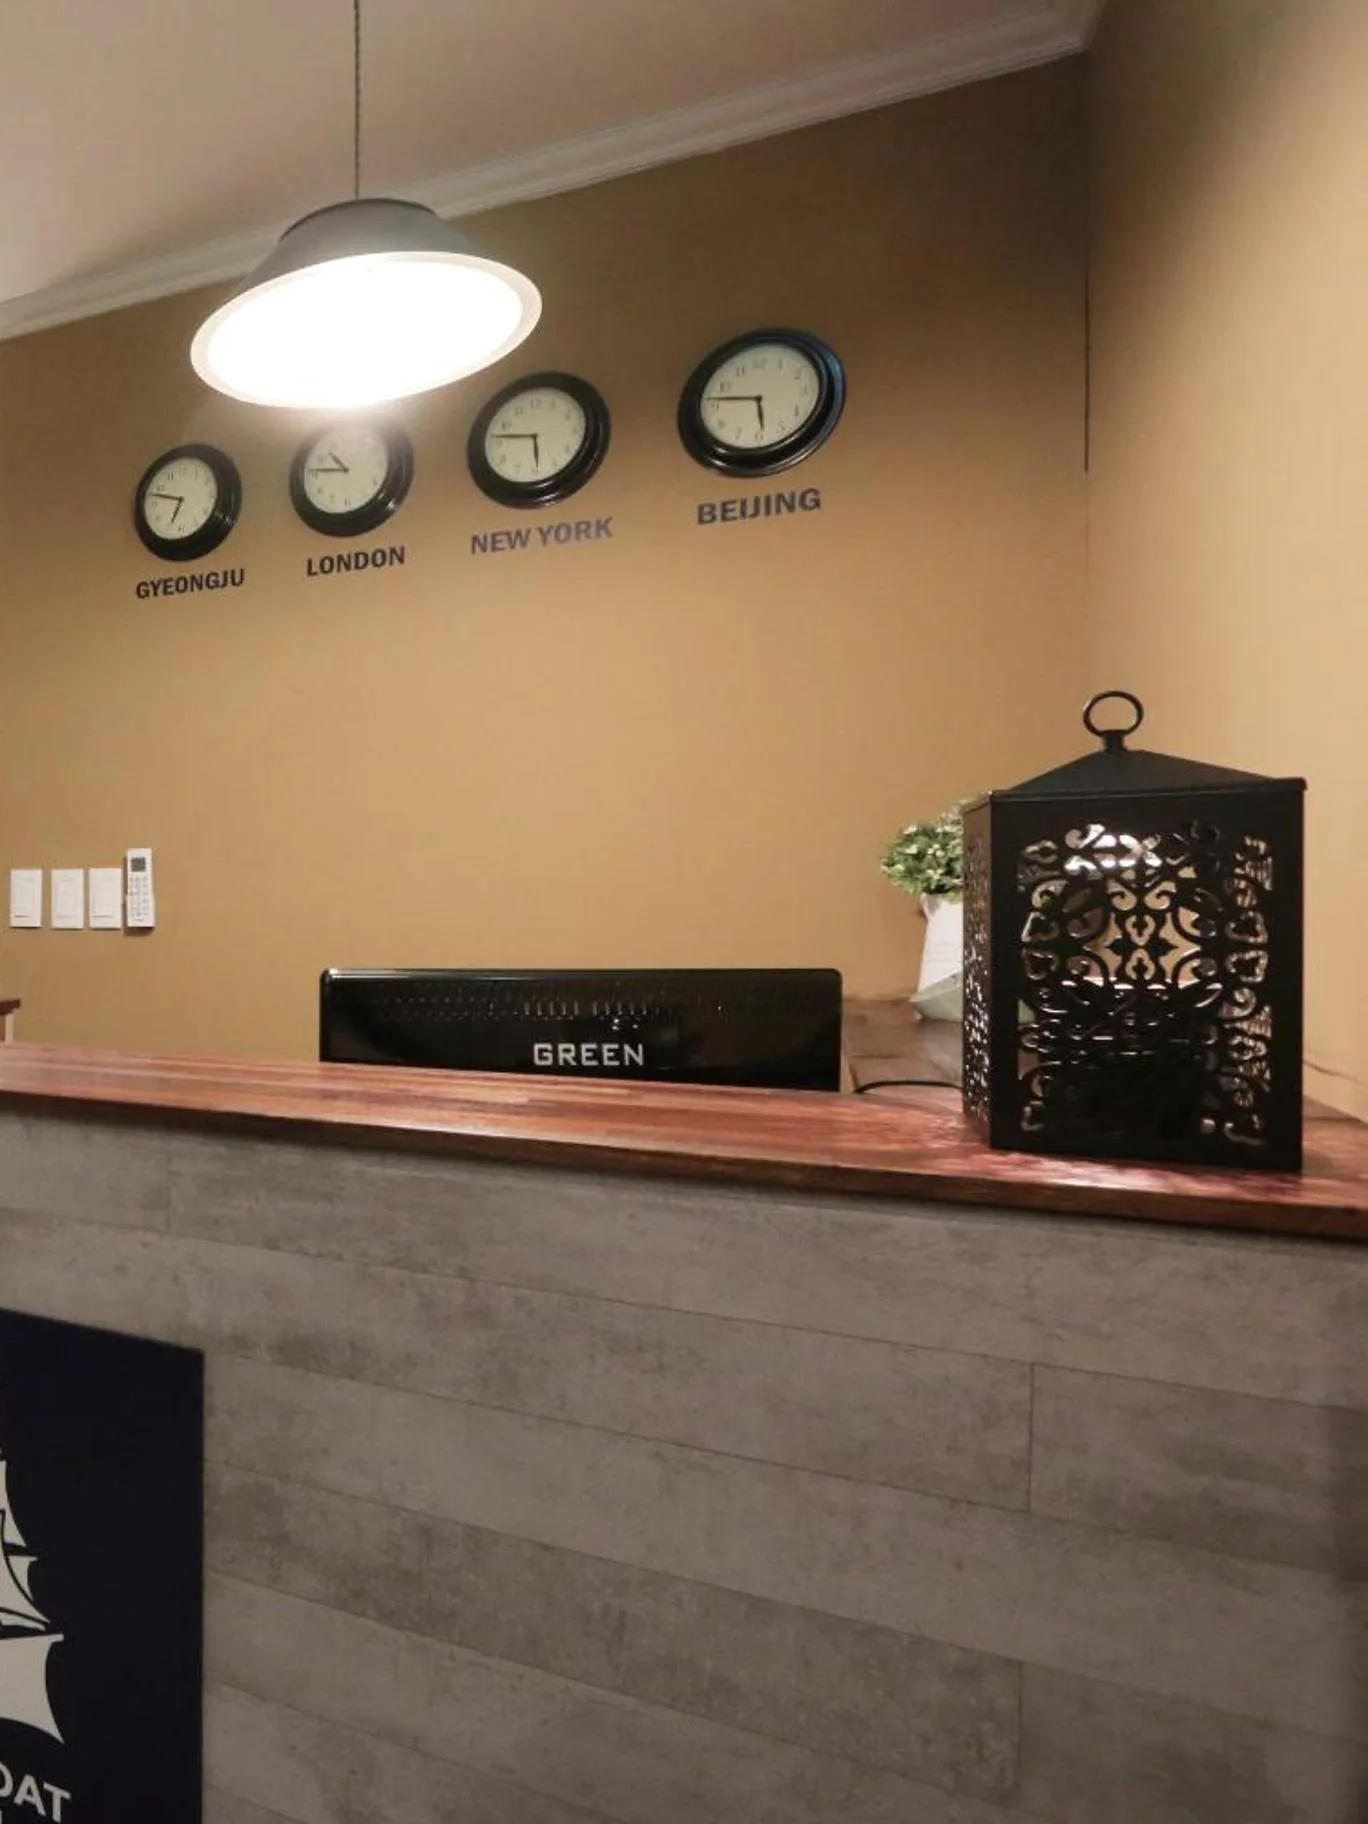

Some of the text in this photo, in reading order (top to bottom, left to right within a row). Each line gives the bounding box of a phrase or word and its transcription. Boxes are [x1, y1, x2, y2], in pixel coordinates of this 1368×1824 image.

[698, 487, 821, 525] BEIJING
[470, 516, 614, 555] NEW YORK
[307, 544, 405, 577] LONDON
[136, 568, 245, 599] GYEONGJU
[533, 1043, 645, 1067] GREEN
